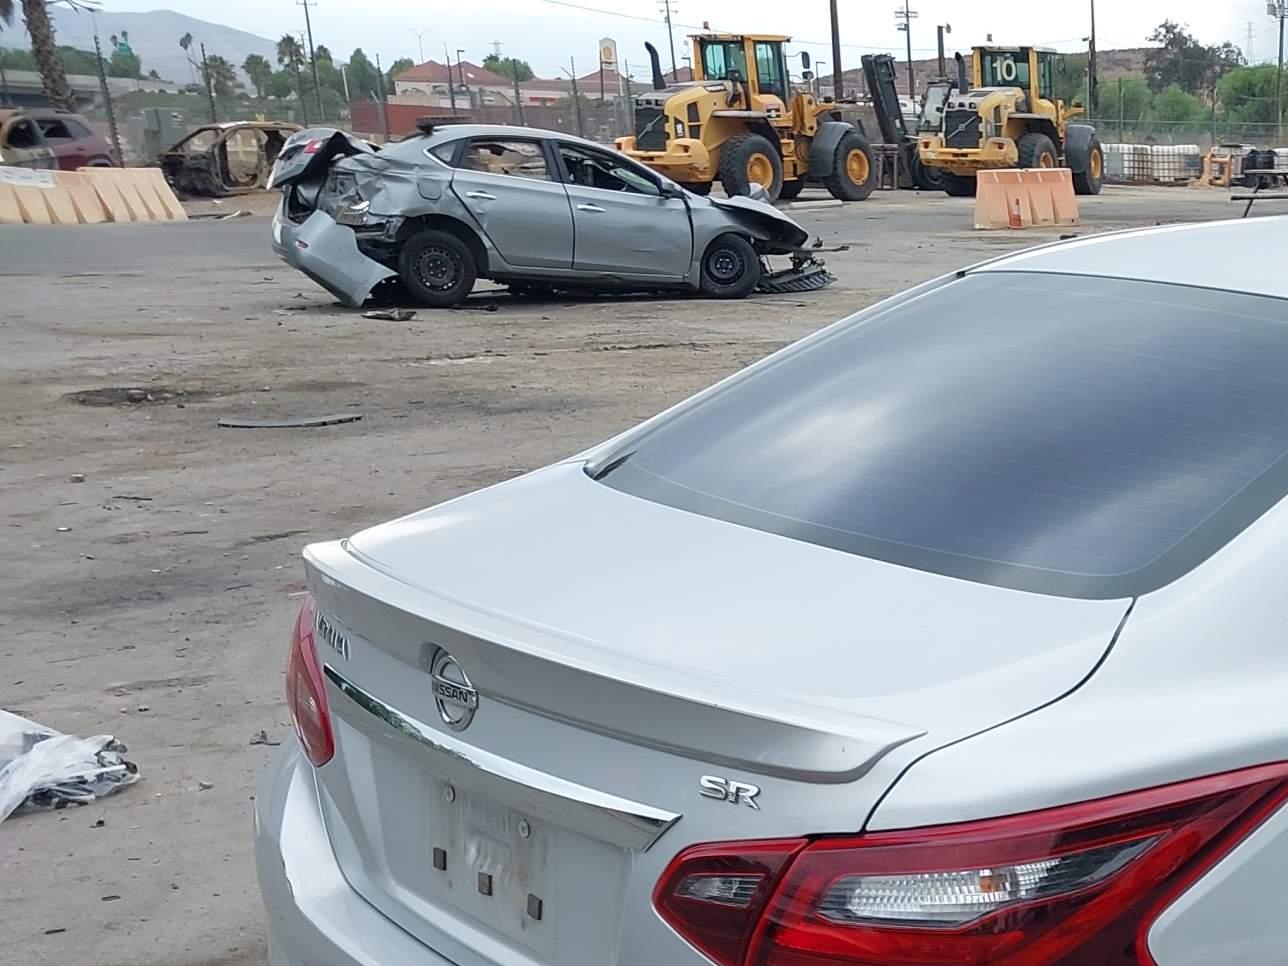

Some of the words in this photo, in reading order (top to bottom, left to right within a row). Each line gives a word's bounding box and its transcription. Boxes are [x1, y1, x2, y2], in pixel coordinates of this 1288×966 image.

[992, 59, 1017, 81] 10
[431, 681, 469, 704] ISSAN
[699, 775, 761, 810] SR
